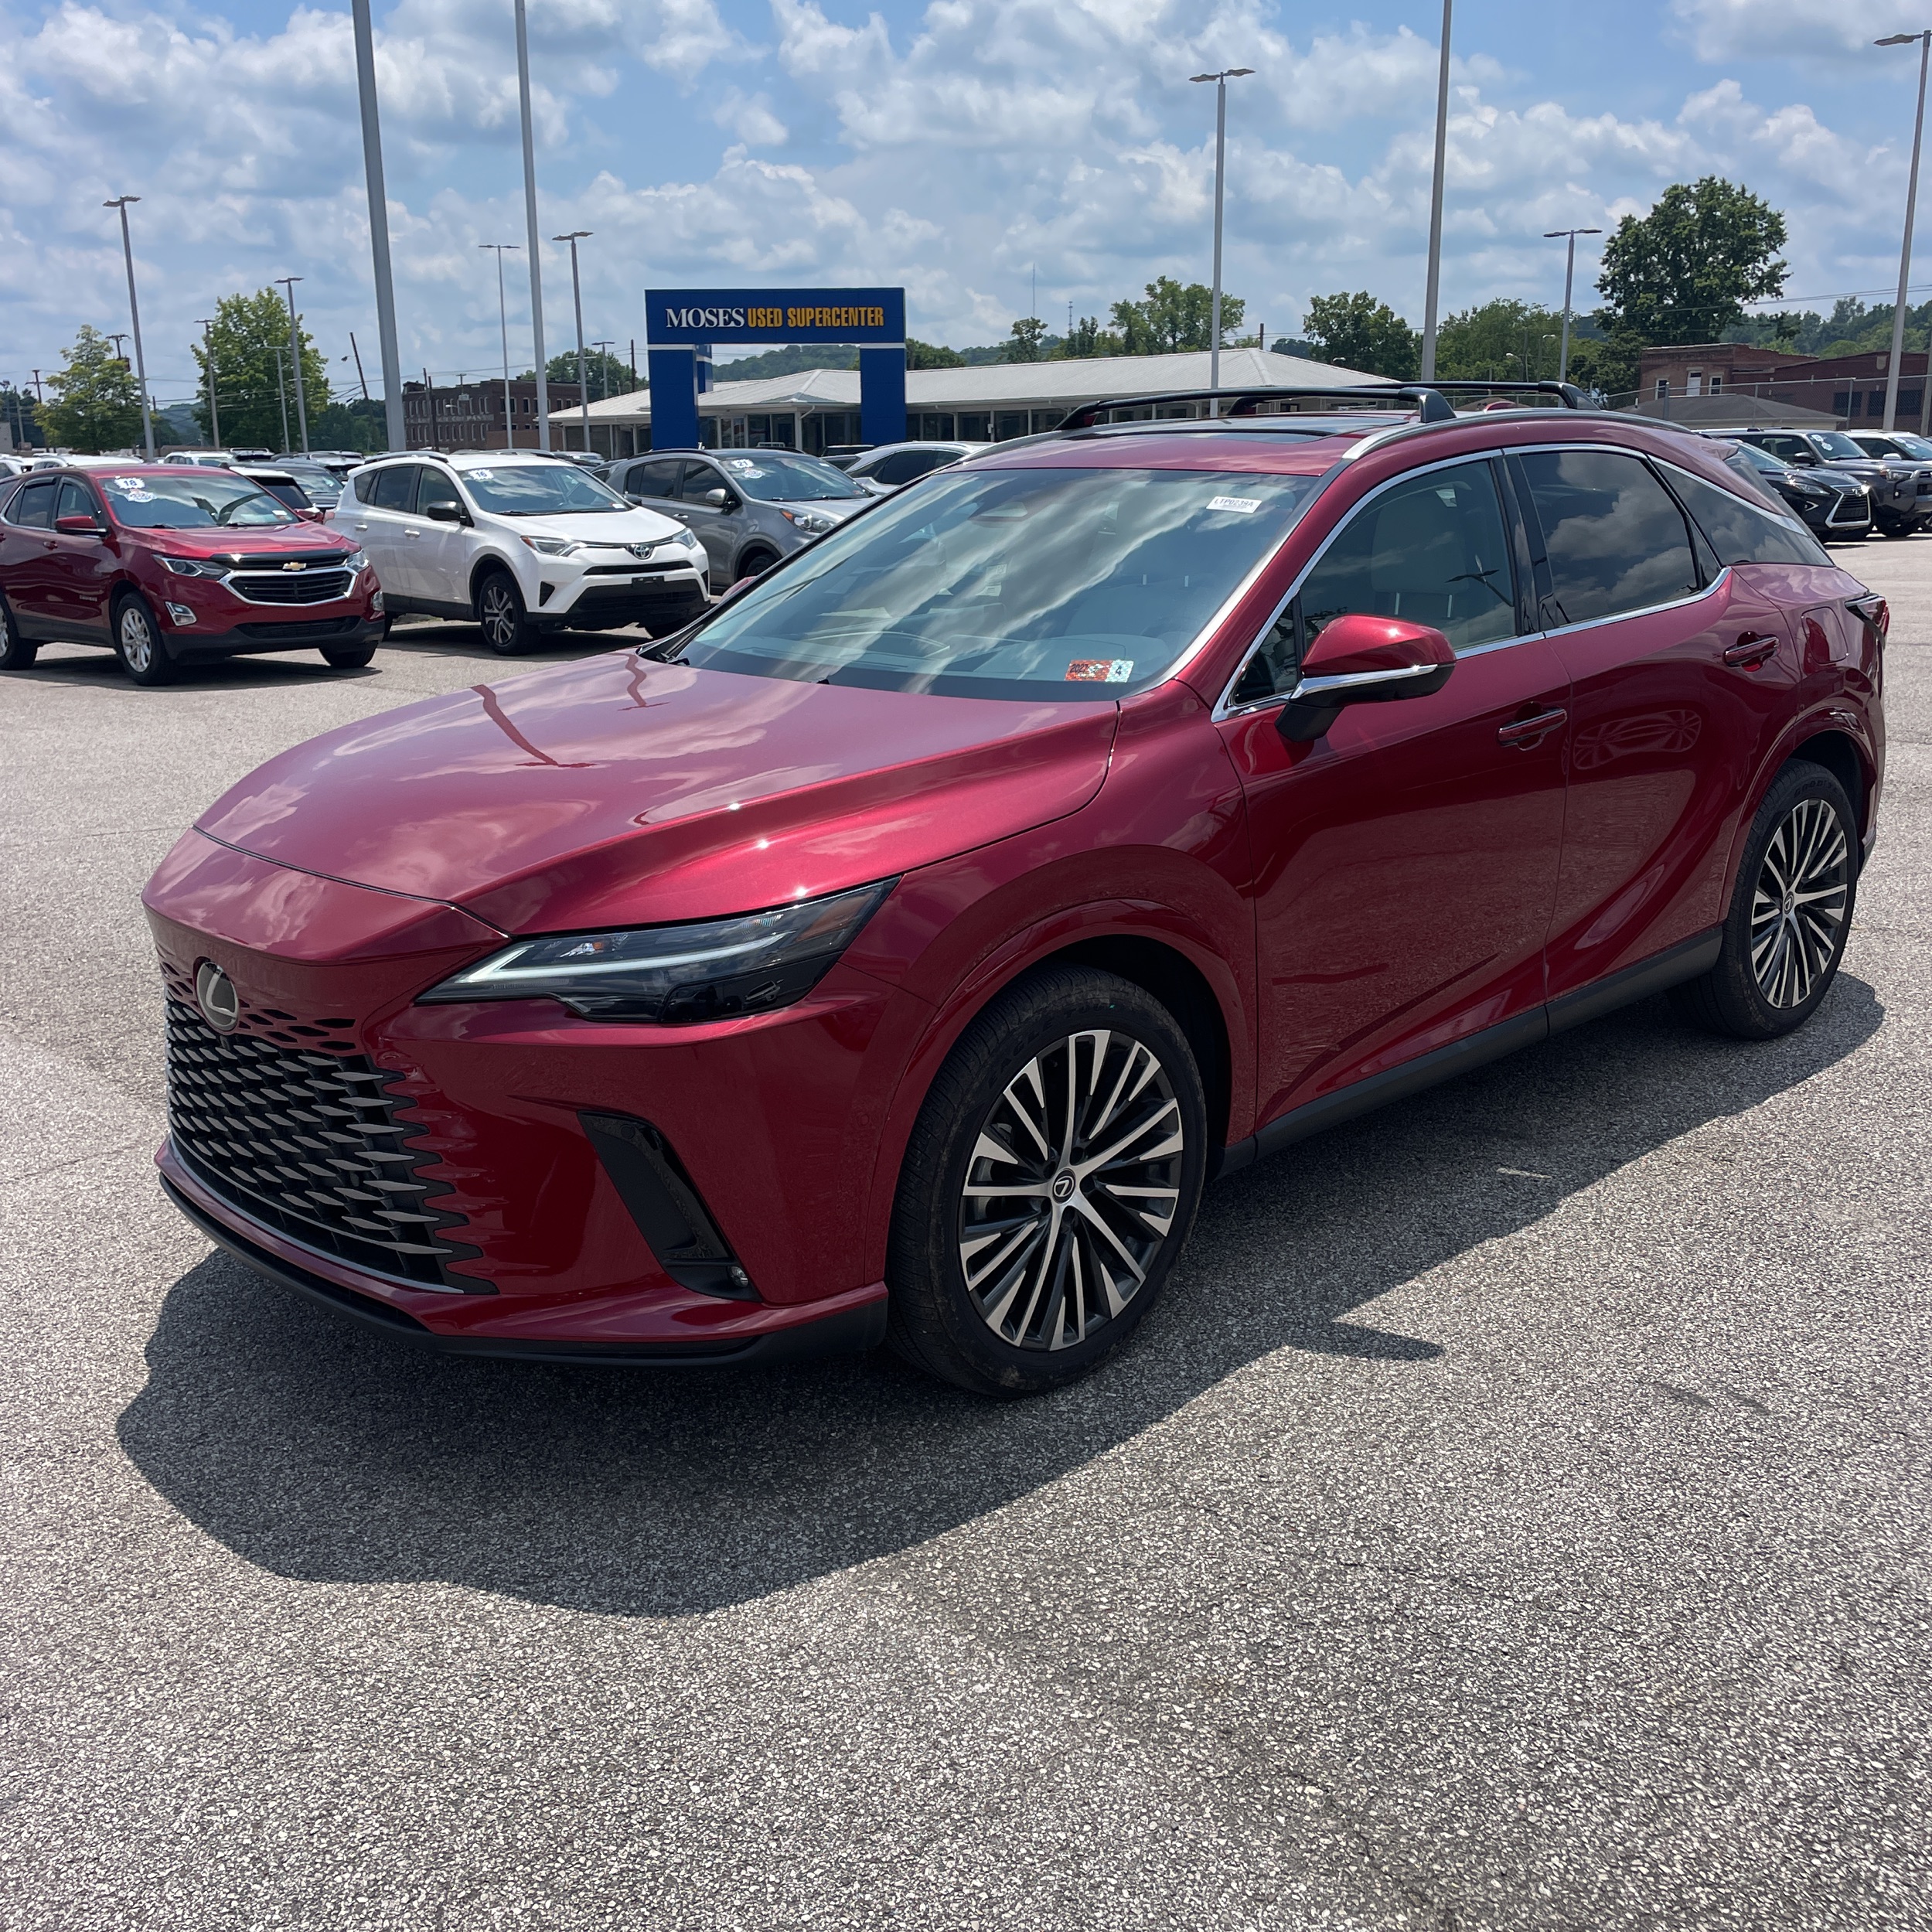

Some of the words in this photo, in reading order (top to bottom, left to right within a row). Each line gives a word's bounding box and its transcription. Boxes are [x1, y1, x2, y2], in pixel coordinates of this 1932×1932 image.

[666, 308, 745, 328] MOSES
[747, 308, 783, 327] USED
[787, 307, 884, 327] SUPERCENTER
